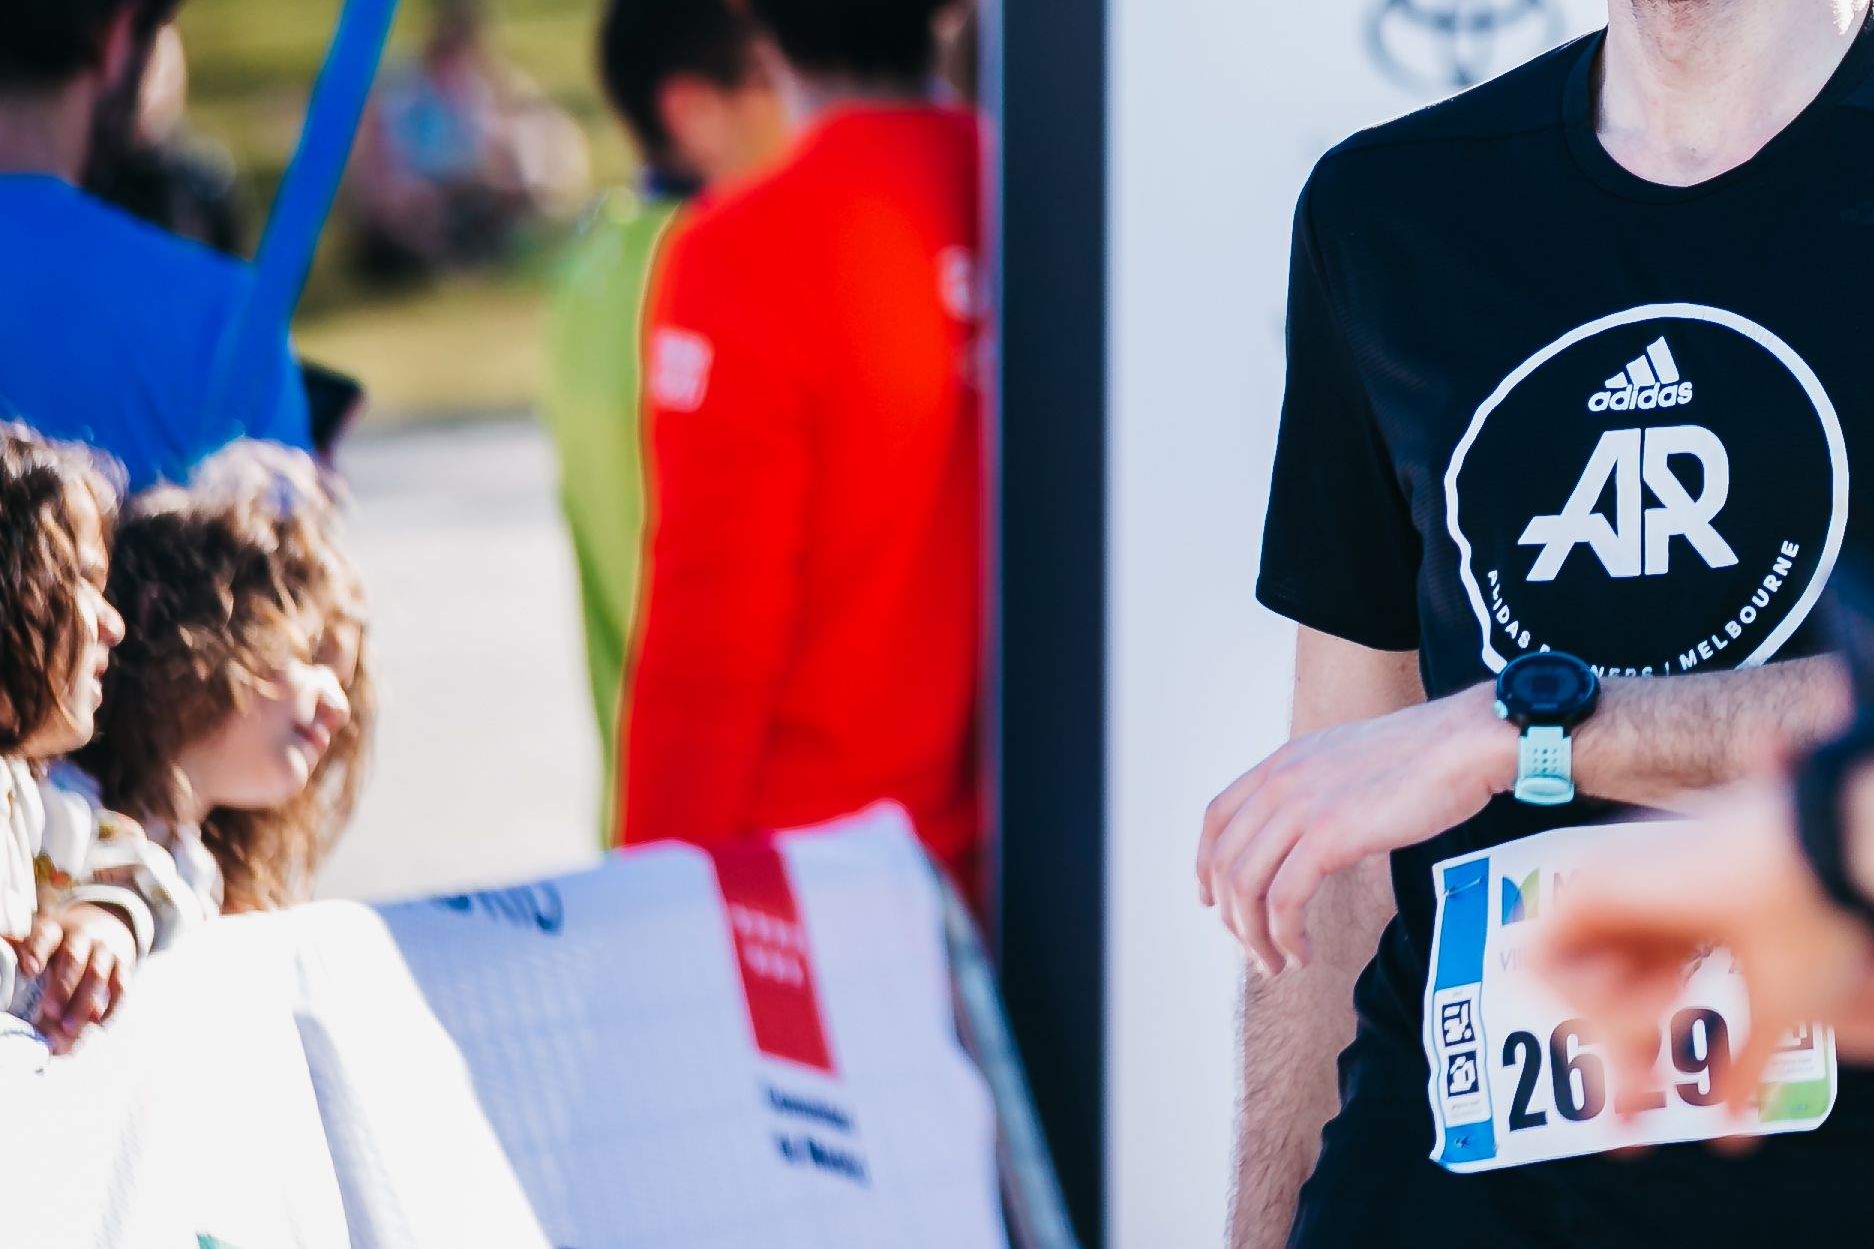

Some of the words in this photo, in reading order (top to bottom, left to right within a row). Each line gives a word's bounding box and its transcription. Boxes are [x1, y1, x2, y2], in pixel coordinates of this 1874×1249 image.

[1588, 380, 1693, 412] adidas
[1517, 425, 1739, 582] AR
[1679, 539, 1801, 670] MELBOURNE
